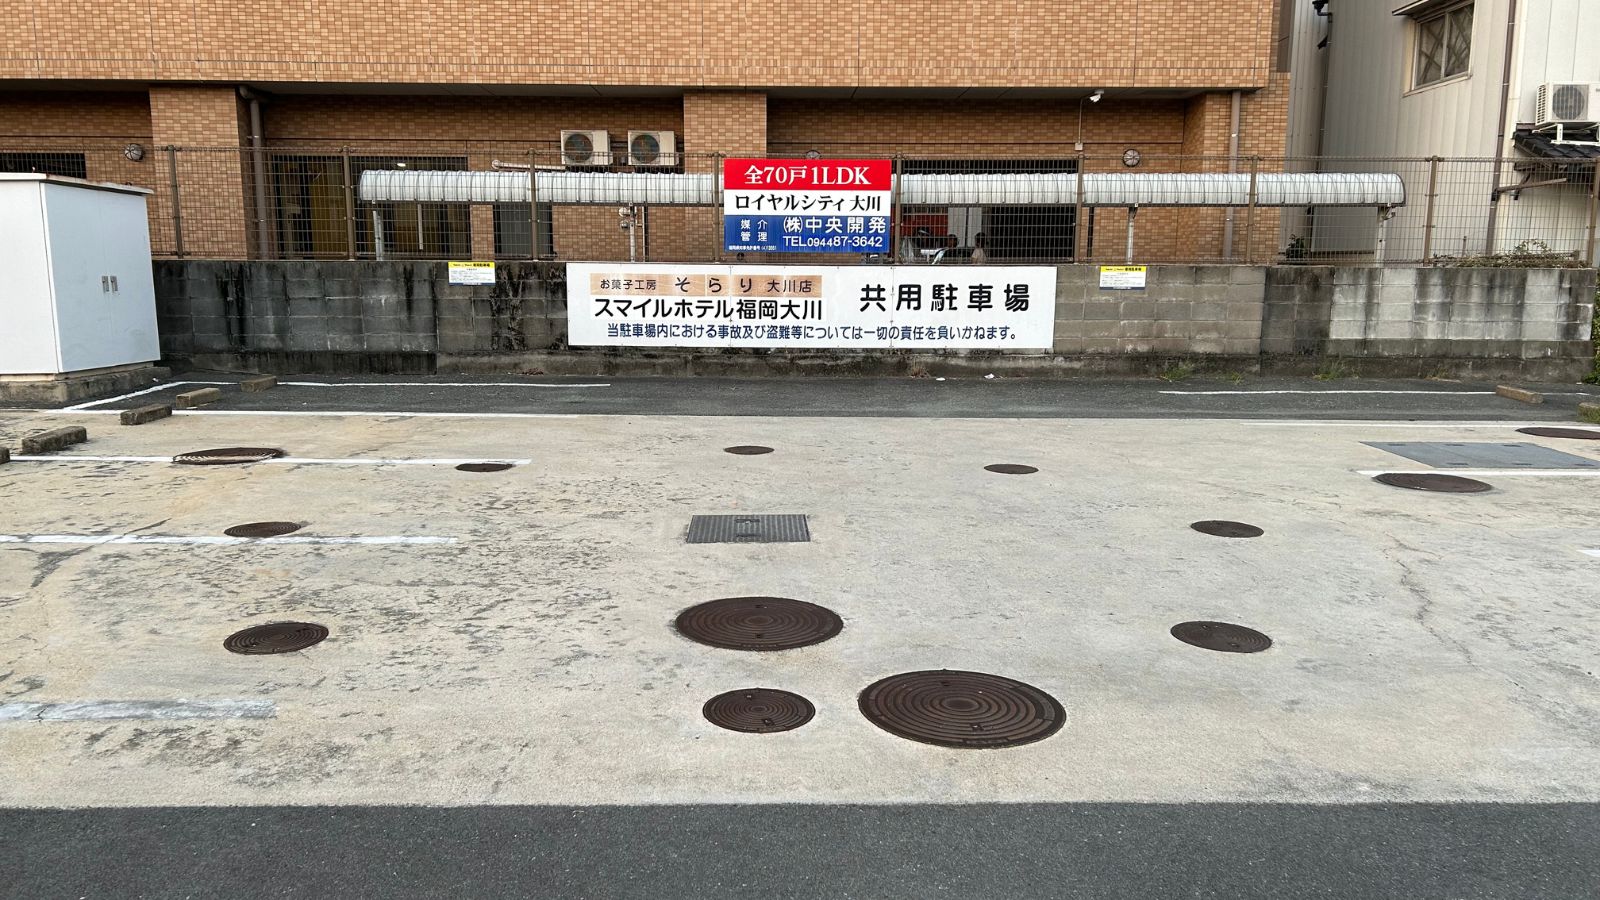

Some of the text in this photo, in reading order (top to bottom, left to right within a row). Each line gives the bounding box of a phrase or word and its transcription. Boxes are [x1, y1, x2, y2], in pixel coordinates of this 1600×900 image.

[740, 231, 768, 242] 管理
[600, 278, 657, 290] お菓子工房
[767, 279, 812, 293] 大川店
[860, 283, 1030, 312] 共用駐車場
[594, 298, 822, 320] スマイルホテル福岡大川
[607, 323, 1016, 341] 当駐車場内における事故及び盗難等については一切の責任を負いかねます。
